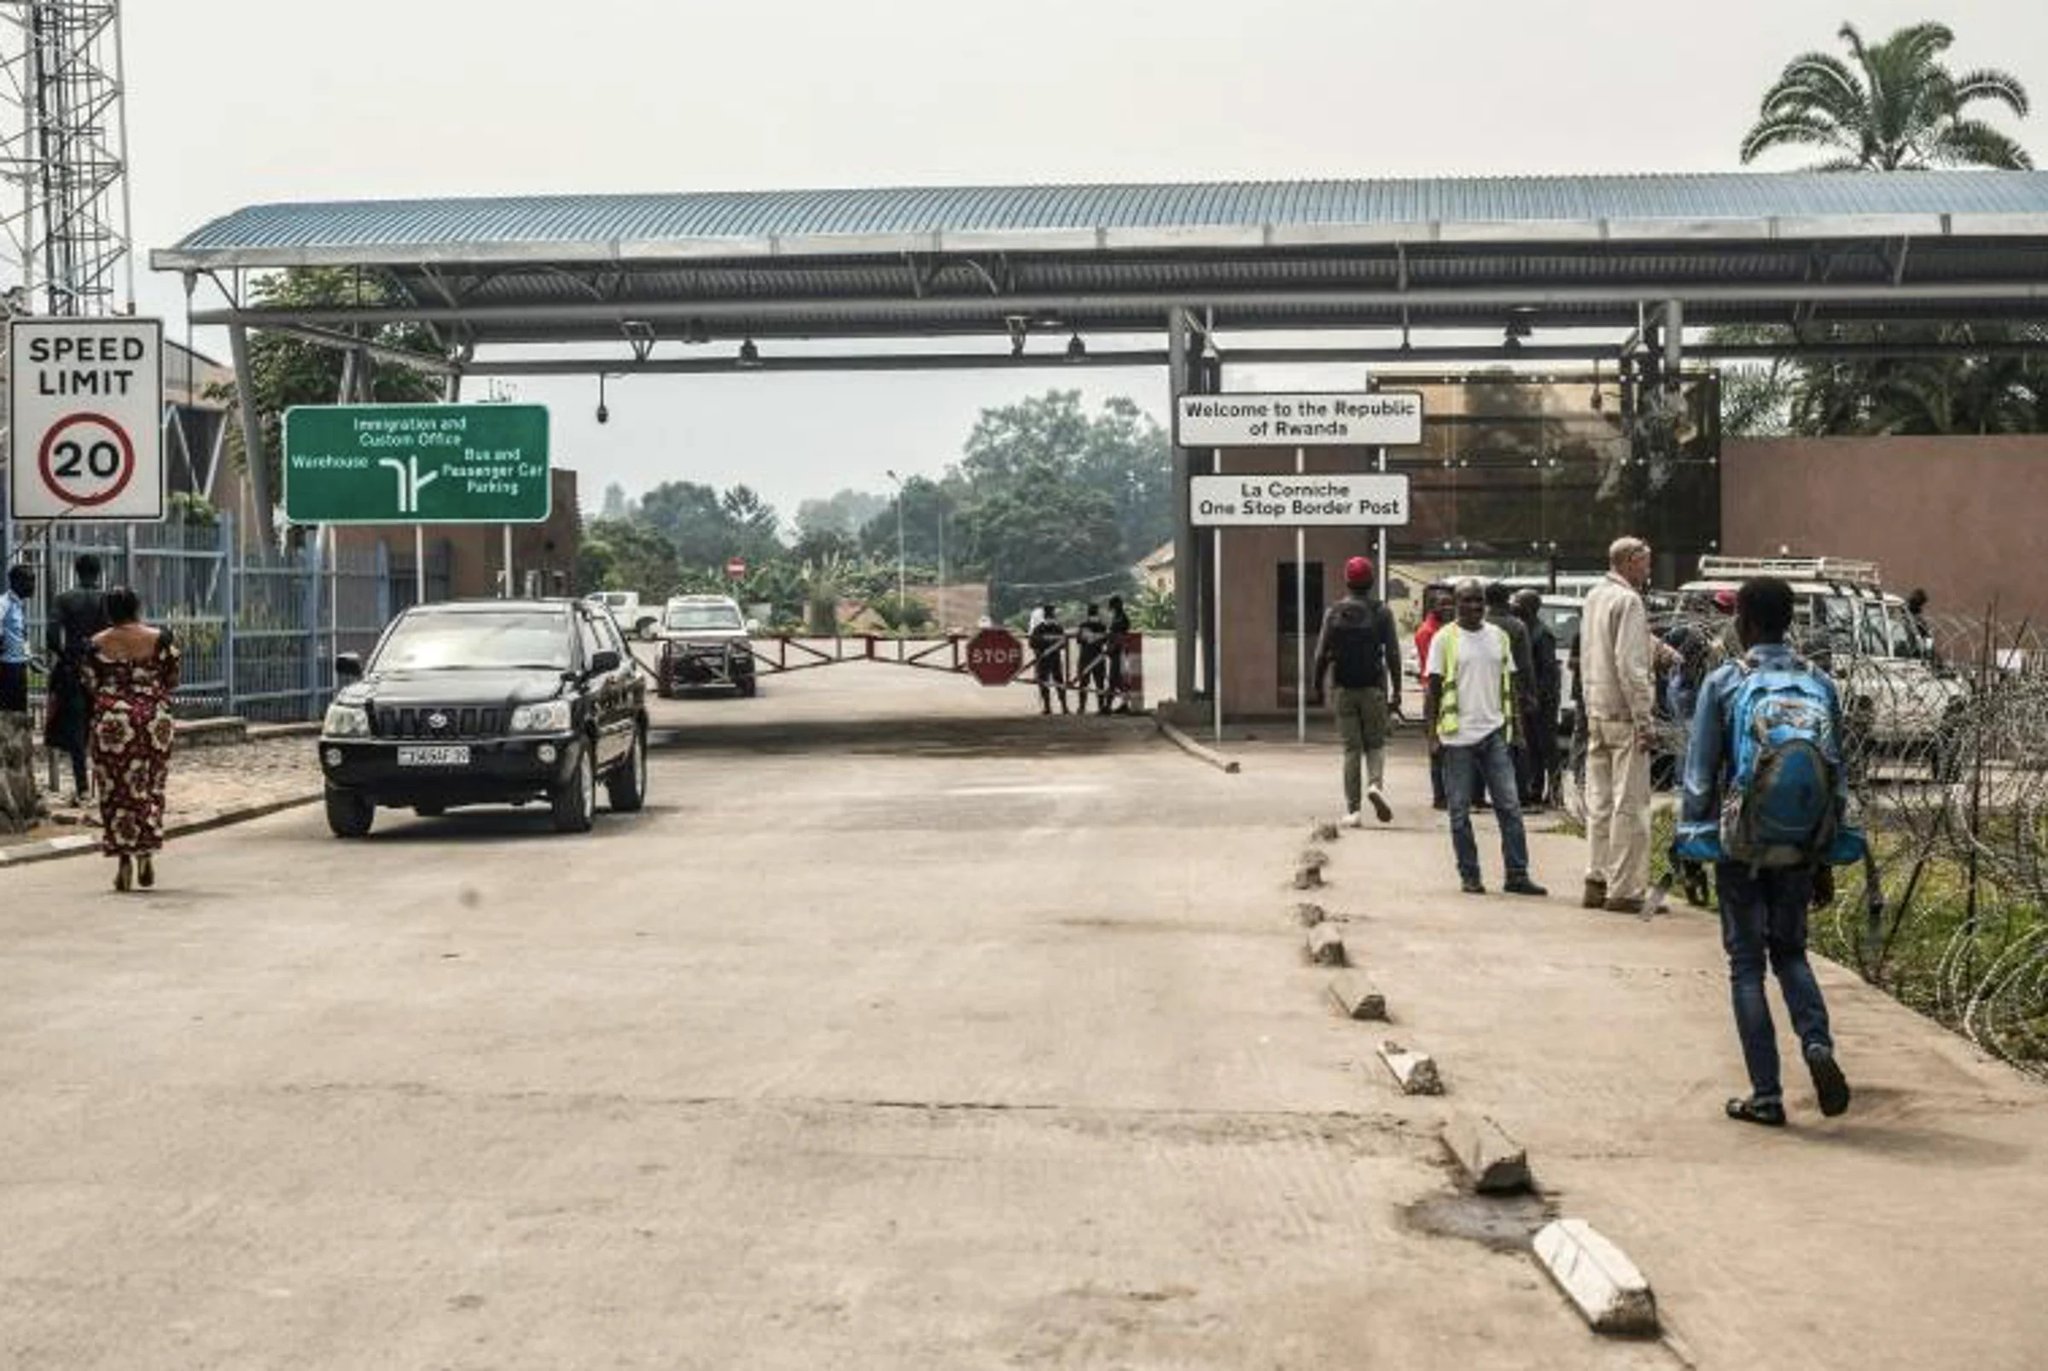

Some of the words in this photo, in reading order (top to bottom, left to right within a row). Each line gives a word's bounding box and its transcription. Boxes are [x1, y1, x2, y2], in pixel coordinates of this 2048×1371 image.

[29, 337, 144, 362] SPEED
[39, 370, 133, 395] LIMIT
[1186, 402, 1267, 418] Welcome
[1274, 403, 1292, 417] to
[1300, 401, 1327, 417] the
[1335, 400, 1416, 417] Republic
[354, 417, 436, 433] Immigration
[440, 416, 466, 431] and
[1250, 421, 1268, 436] of
[1276, 421, 1348, 436] Rwanda
[359, 433, 414, 447] Custom
[418, 432, 462, 446] Office
[53, 440, 120, 478] 20
[292, 454, 368, 469] Warehouse
[465, 448, 491, 461] Bus
[493, 448, 520, 460] and
[442, 464, 512, 479] Passenger
[518, 465, 542, 477] Car
[467, 480, 518, 496] Parking
[1241, 483, 1262, 497] La
[1268, 482, 1349, 497] Corniche
[1200, 501, 1235, 515] One
[1243, 500, 1286, 518] Stop
[1293, 500, 1351, 515] Border
[1360, 500, 1399, 515] Post
[971, 647, 1020, 664] STOP
